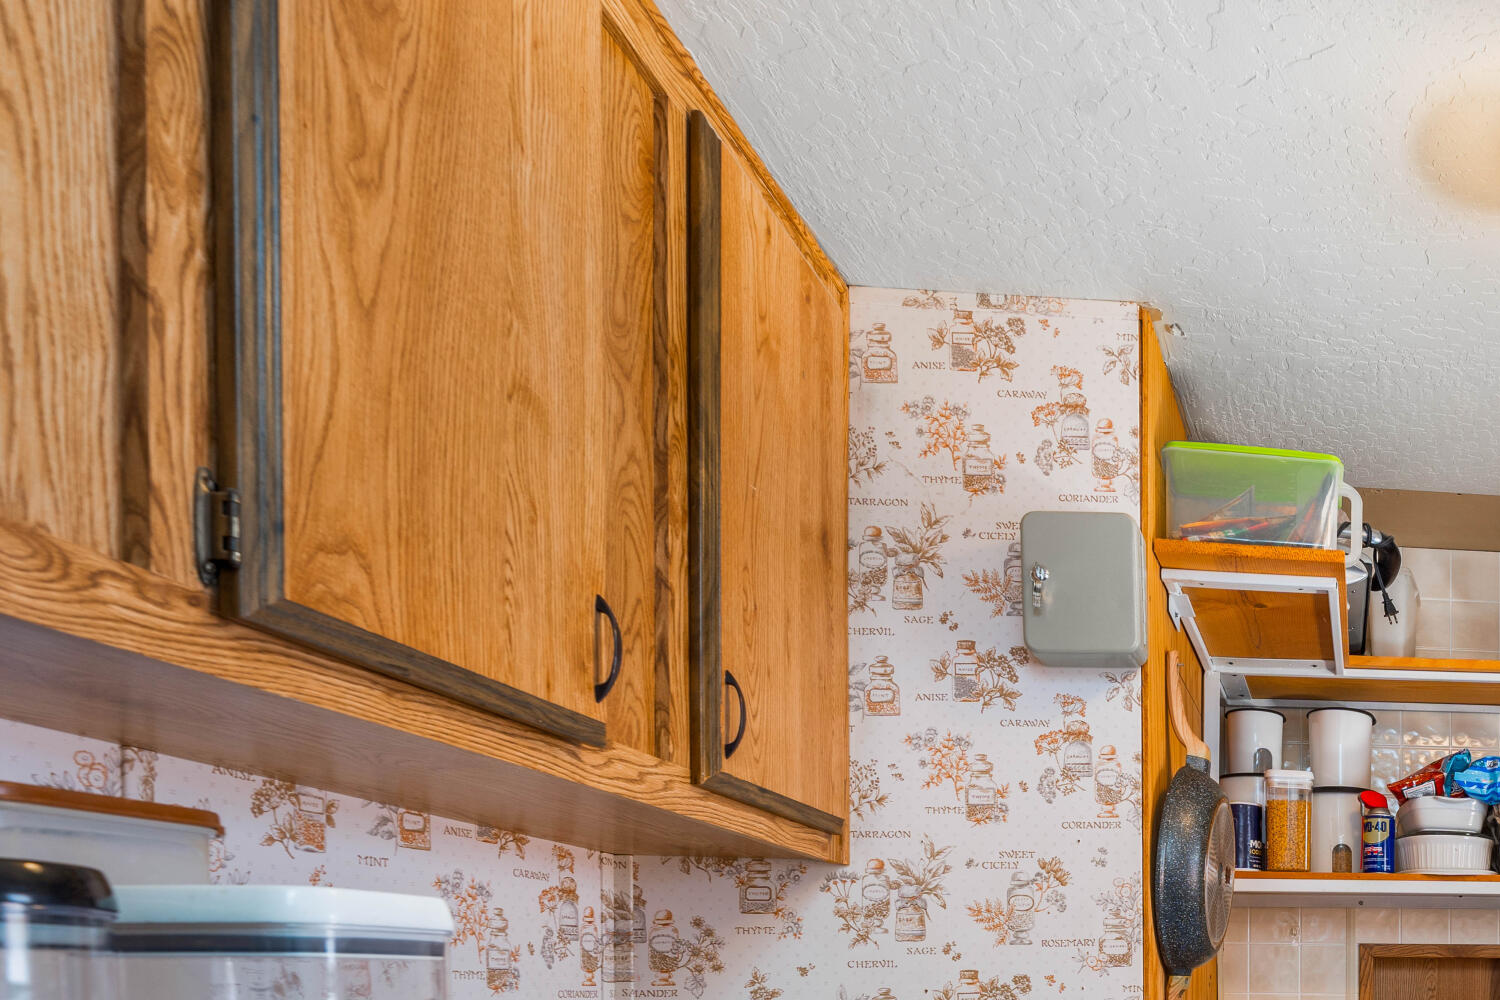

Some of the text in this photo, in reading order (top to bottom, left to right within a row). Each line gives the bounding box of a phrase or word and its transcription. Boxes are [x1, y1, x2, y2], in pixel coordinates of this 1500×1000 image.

[912, 359, 946, 370] ANISE
[997, 389, 1047, 400] CARAWAY
[922, 475, 961, 485] THYME
[1058, 493, 1118, 504] CORIANDER
[978, 531, 1016, 542] CICELY
[904, 614, 933, 625] SAGE
[915, 692, 948, 702] ANISE
[999, 718, 1050, 729] CARAWAY
[925, 805, 964, 815] THYME
[1061, 820, 1122, 831] CORIANDER
[443, 825, 473, 839] ANISE
[850, 829, 911, 840] TARRAGON
[998, 850, 1036, 860] SWEET
[357, 854, 390, 868] MINT
[981, 860, 1020, 870] CICELY
[512, 868, 550, 881] CARAWAY
[734, 926, 776, 936] THYME
[1041, 937, 1096, 948] ROSEMARY
[906, 945, 937, 956] SAGE
[847, 959, 898, 969] CHERVIL
[452, 970, 486, 981] THYME
[557, 989, 599, 999] CORIANDER
